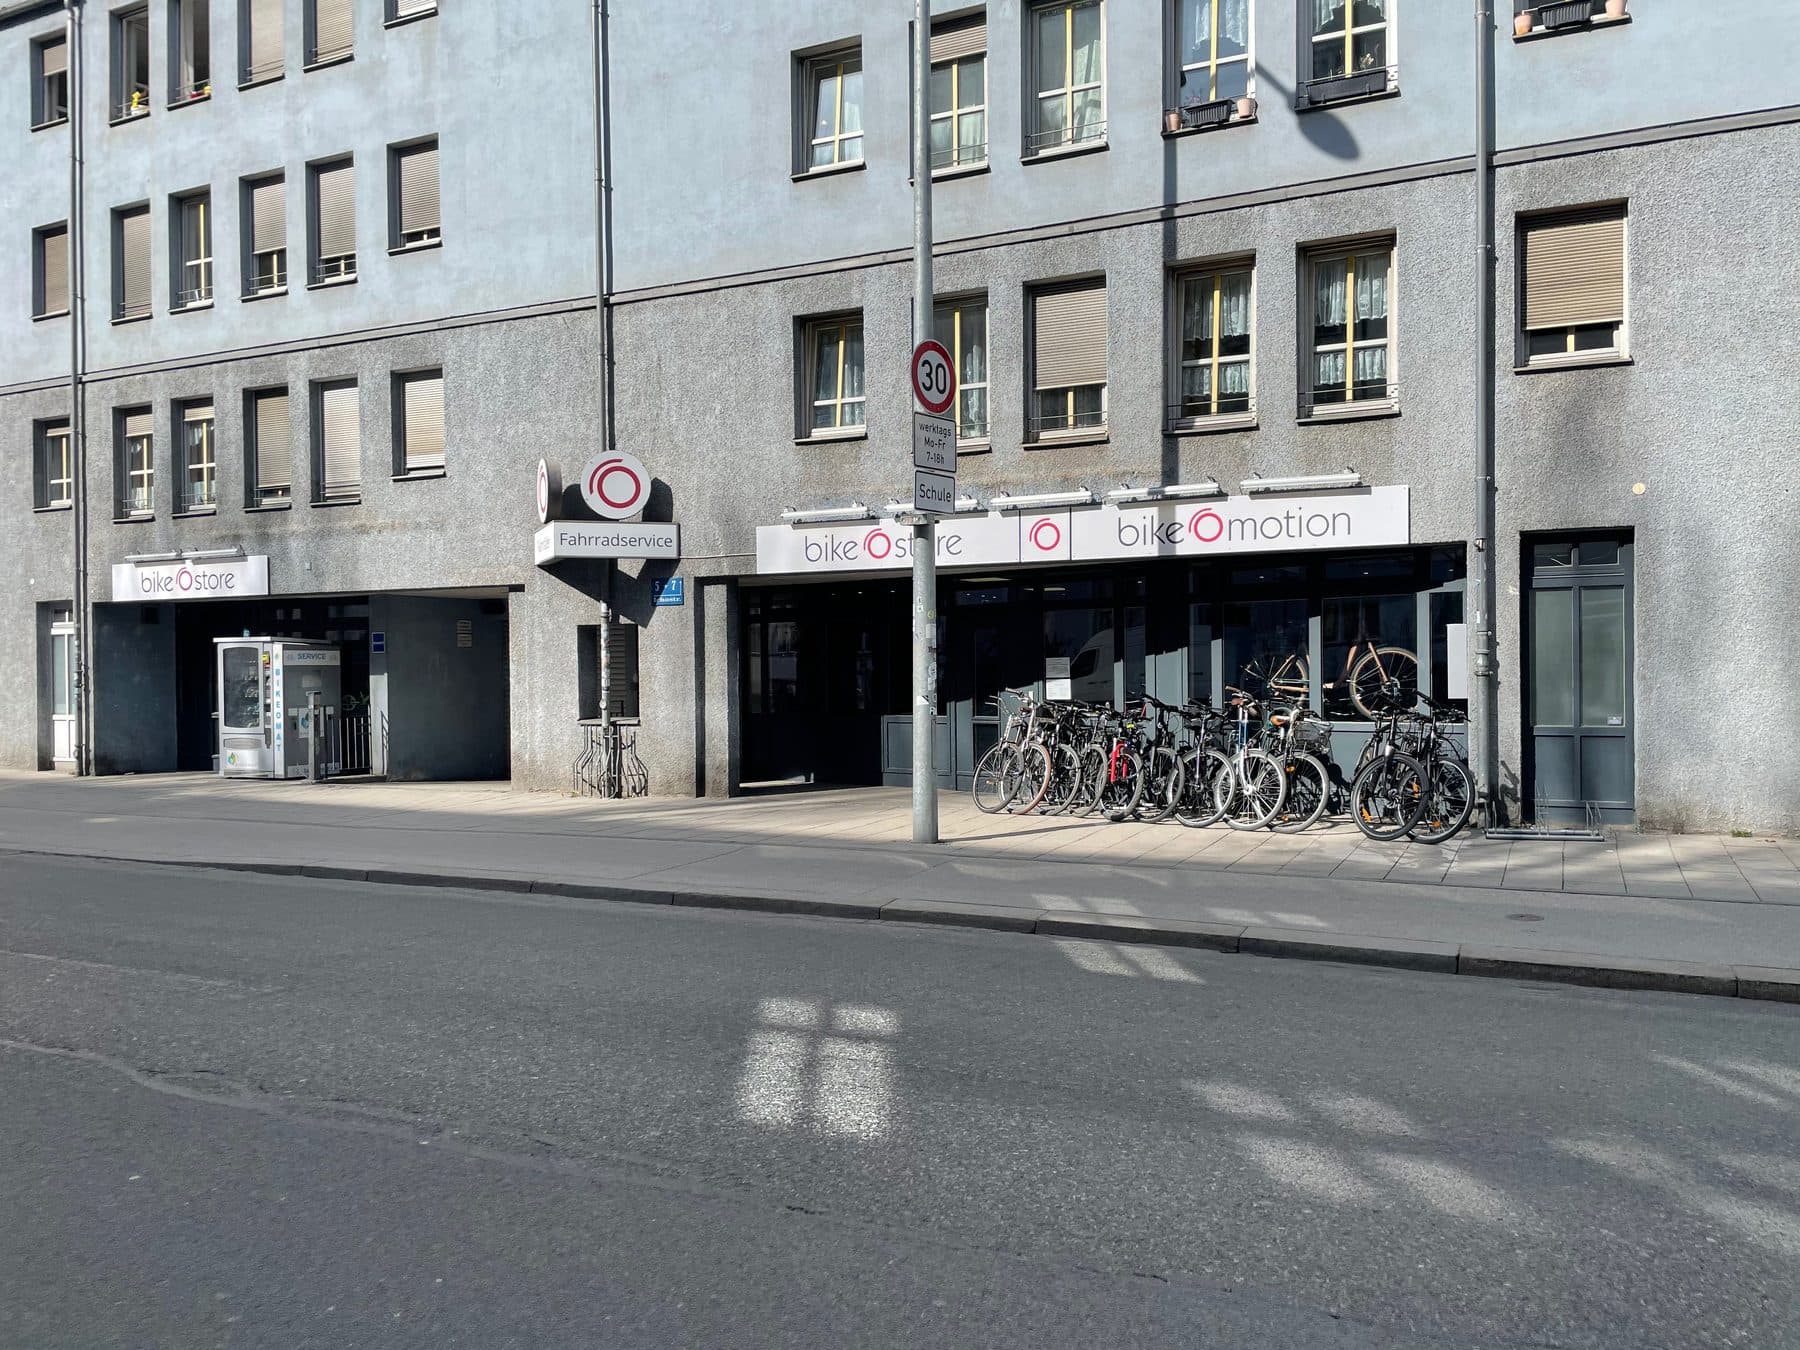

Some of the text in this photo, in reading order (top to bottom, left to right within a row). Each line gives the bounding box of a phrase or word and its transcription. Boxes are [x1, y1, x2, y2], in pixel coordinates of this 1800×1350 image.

[921, 359, 947, 395] 30
[919, 422, 952, 438] werktags
[924, 436, 946, 450] Mo-Fr
[926, 451, 945, 465] 7-18h
[919, 483, 952, 503] Schule
[559, 532, 673, 548] Fahrradservice
[894, 533, 963, 559] stre
[654, 581, 660, 592] 5
[297, 652, 327, 661] SERVICE
